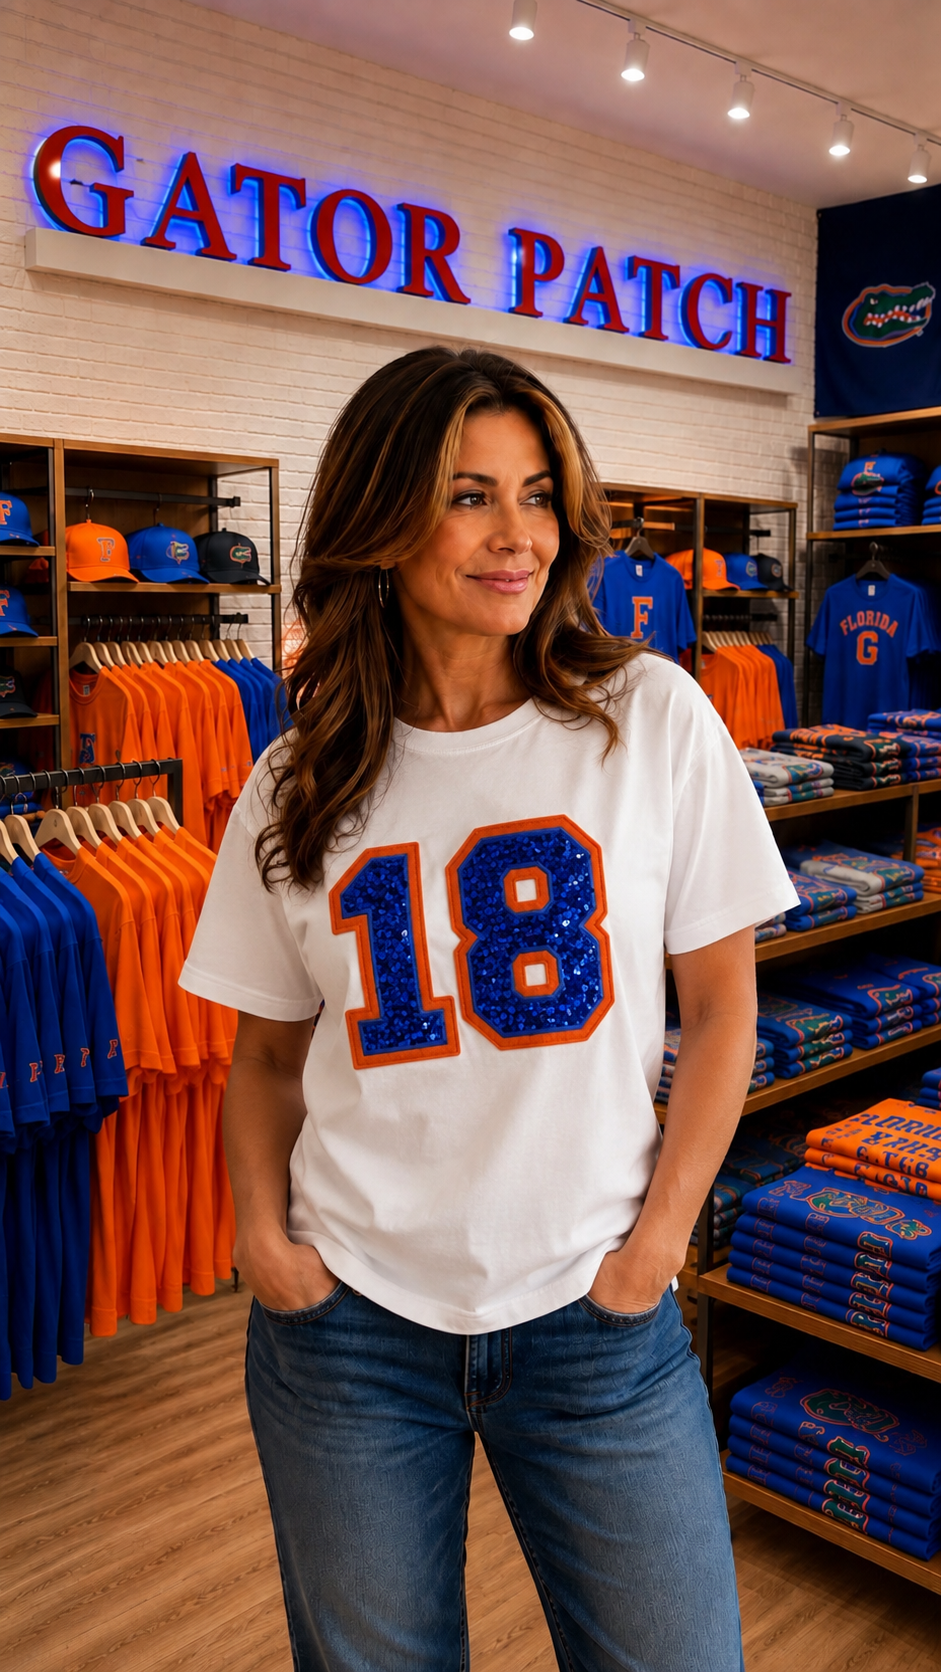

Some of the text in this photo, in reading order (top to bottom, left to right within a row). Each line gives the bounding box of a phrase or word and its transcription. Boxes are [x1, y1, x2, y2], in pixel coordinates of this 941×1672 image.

[34, 125, 792, 364] GATOR PATCH
[631, 596, 653, 639] F
[840, 610, 899, 638] FLORIDA
[856, 630, 878, 665] G
[328, 814, 615, 1070] 18
